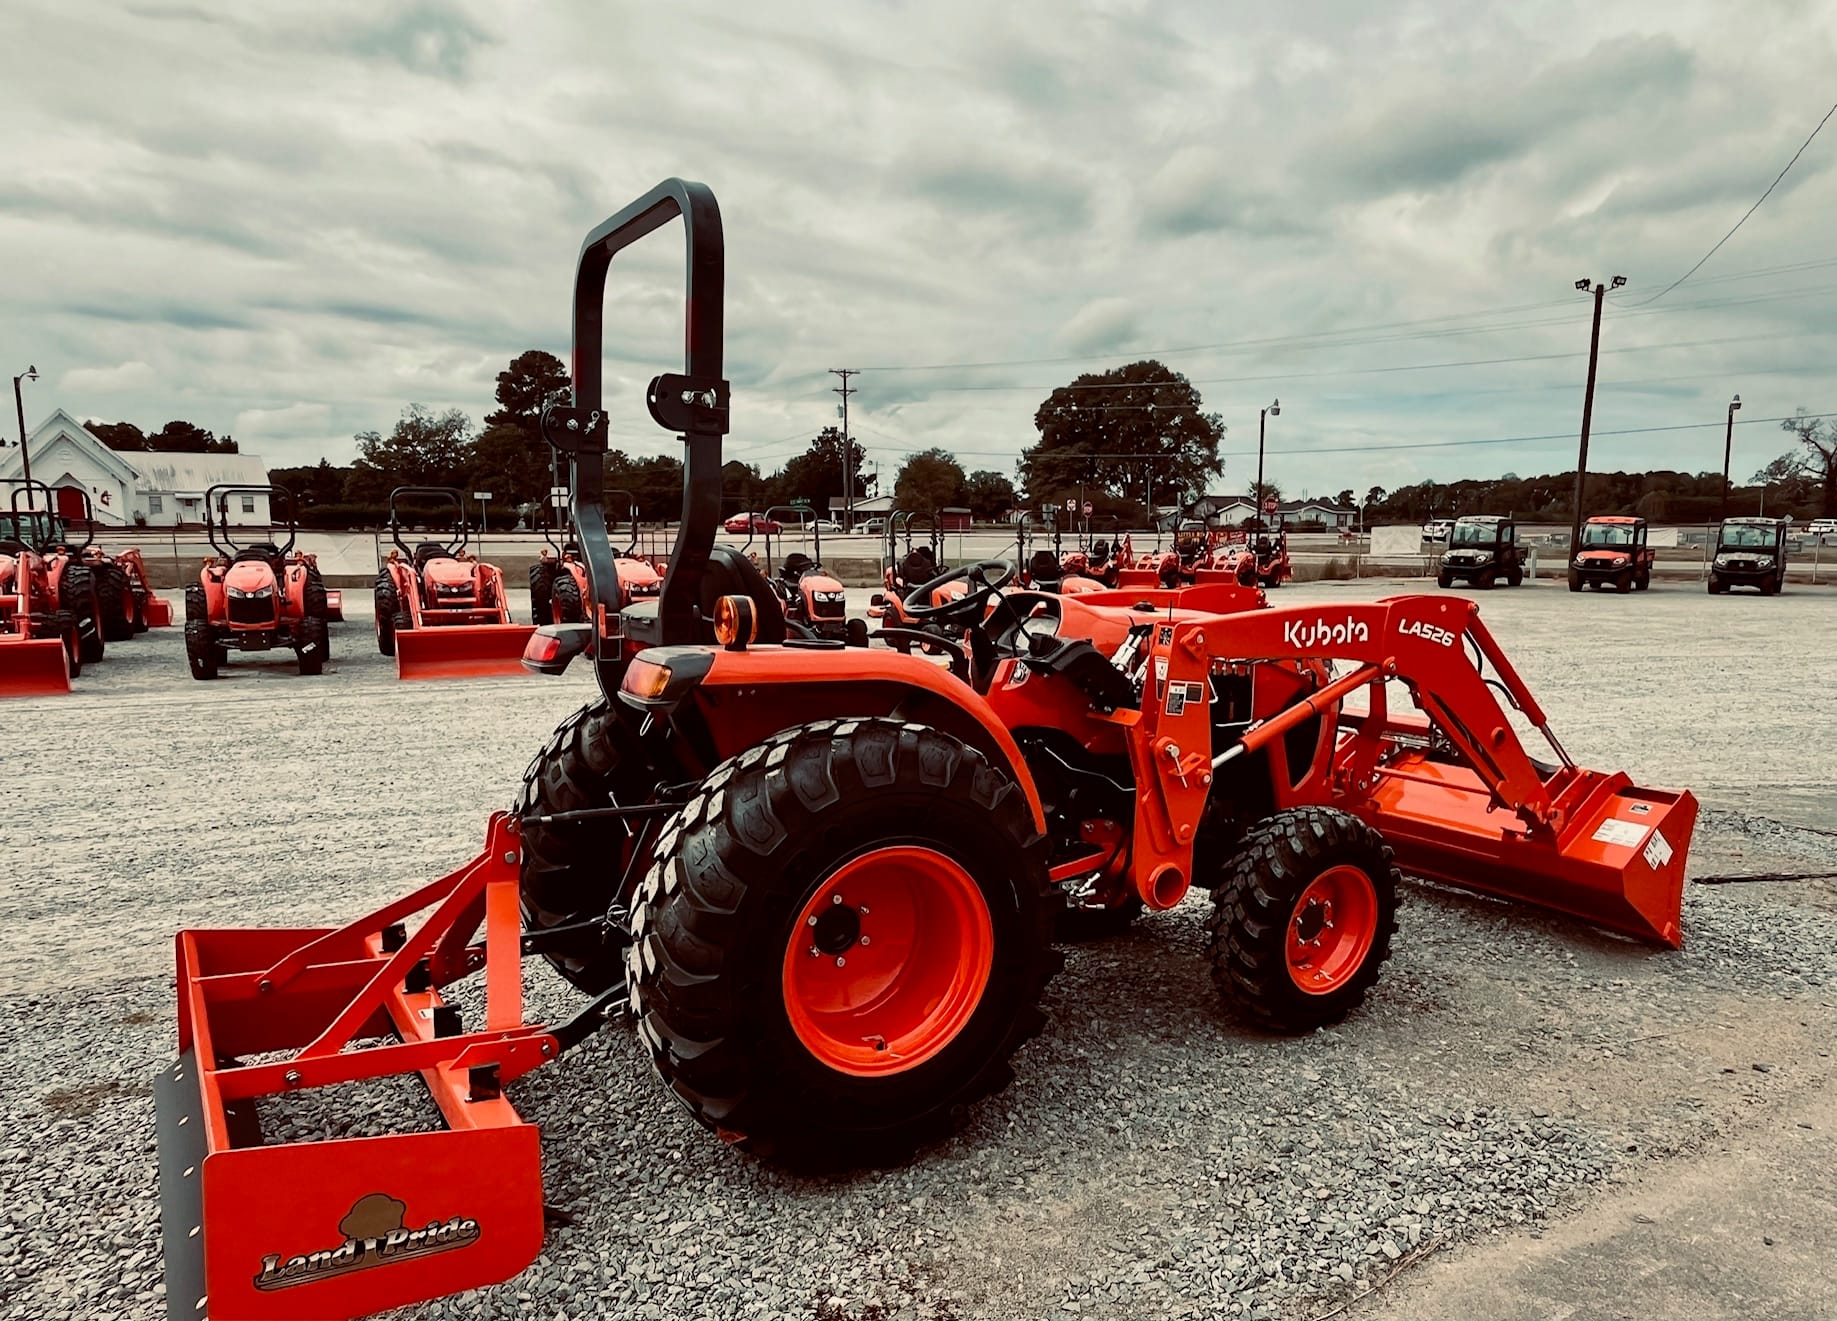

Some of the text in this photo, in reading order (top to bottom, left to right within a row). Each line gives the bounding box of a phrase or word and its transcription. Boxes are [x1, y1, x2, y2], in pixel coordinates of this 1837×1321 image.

[1283, 615, 1369, 649] Kubota
[1398, 618, 1456, 647] LA526
[259, 1215, 480, 1283] Land Pride
